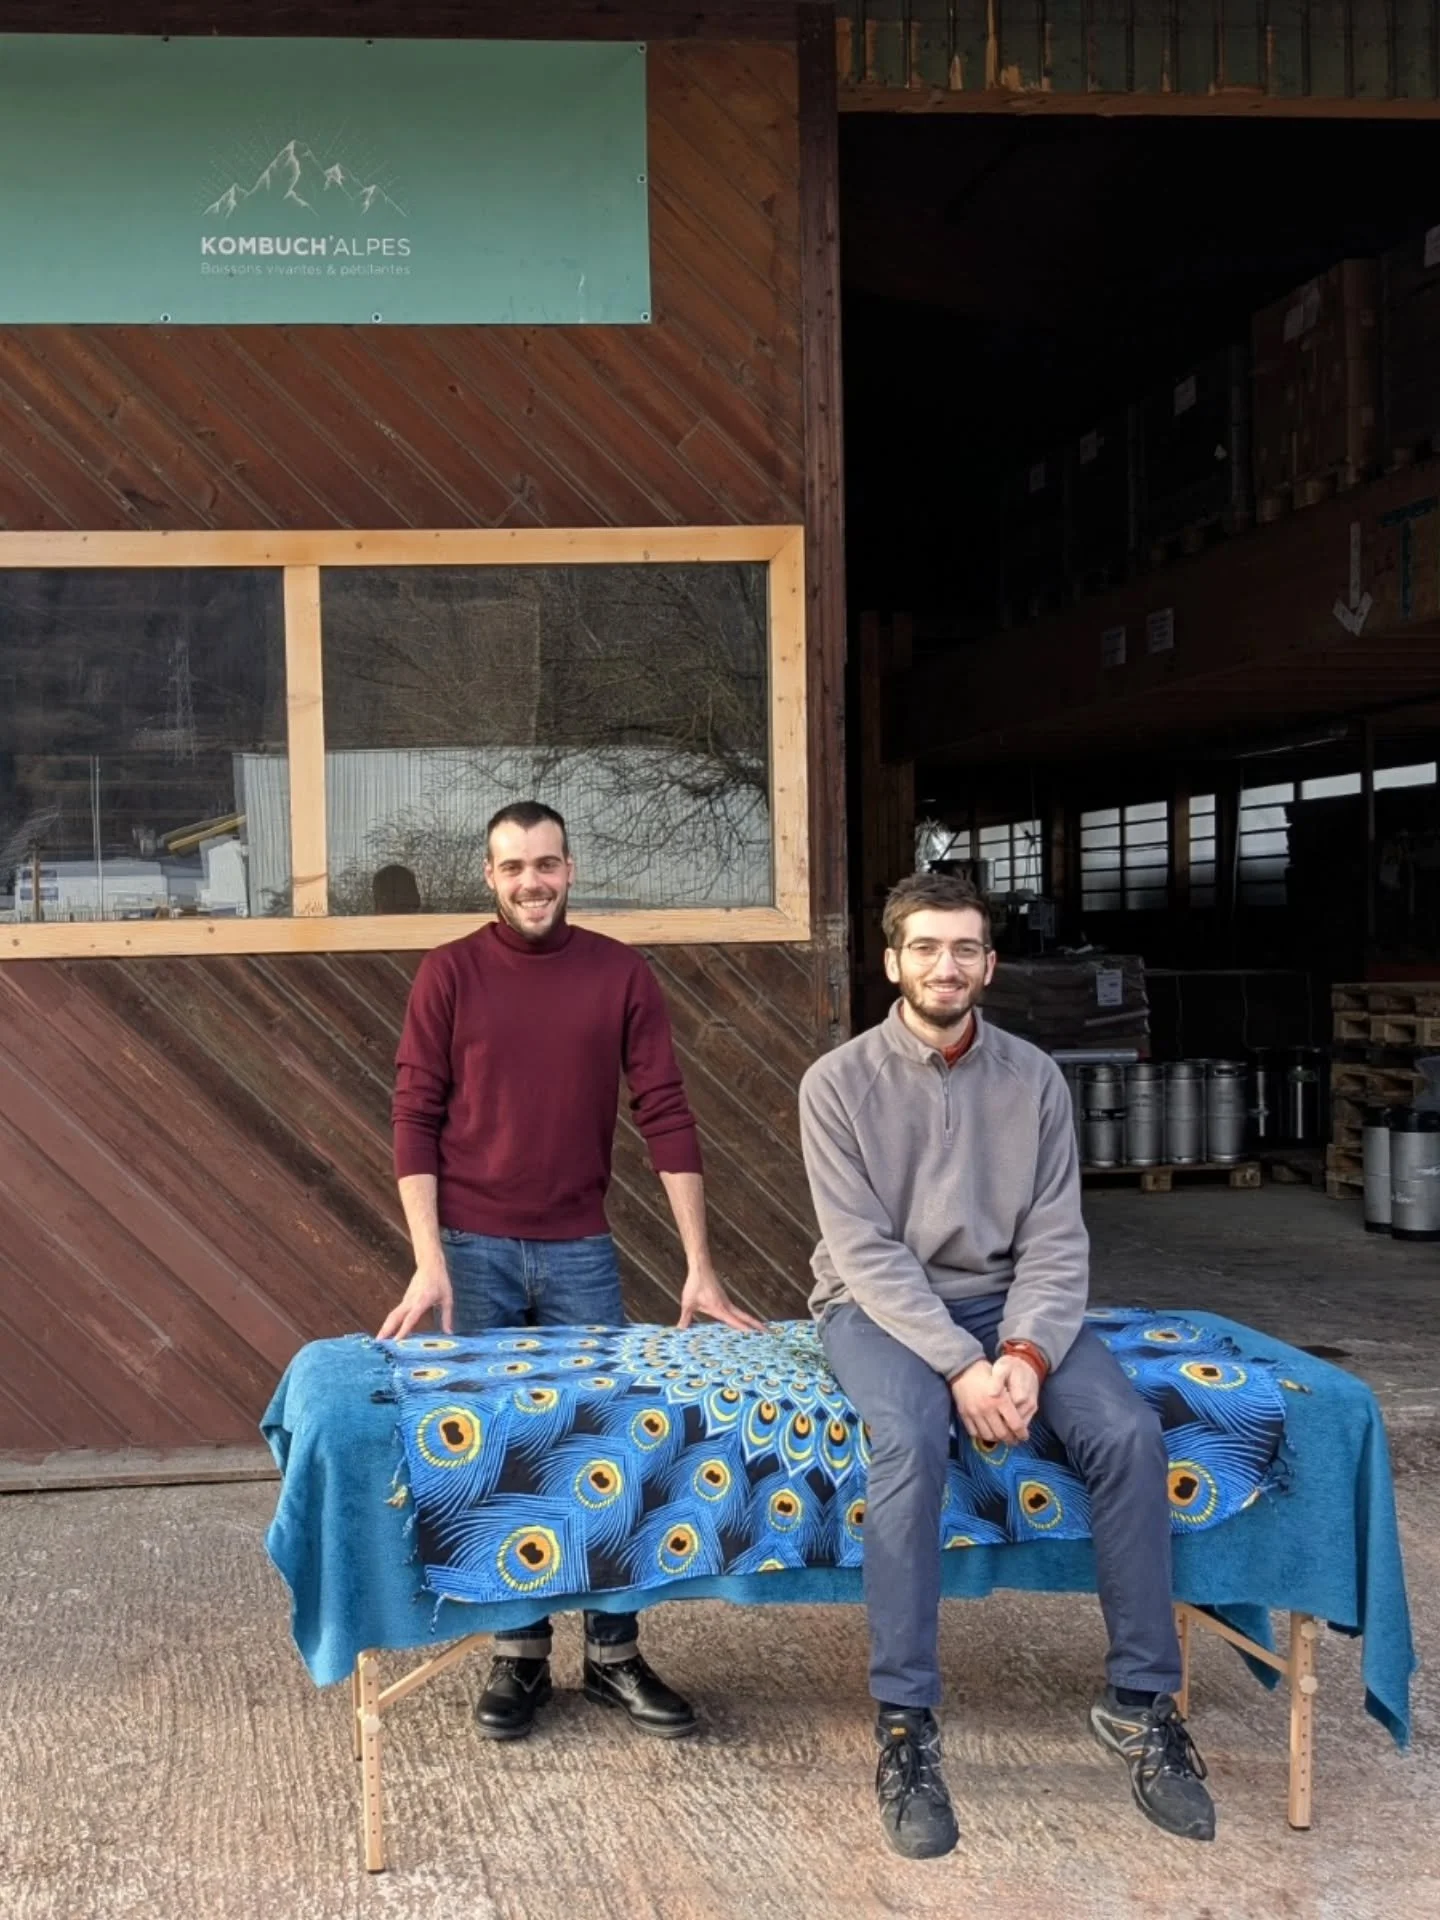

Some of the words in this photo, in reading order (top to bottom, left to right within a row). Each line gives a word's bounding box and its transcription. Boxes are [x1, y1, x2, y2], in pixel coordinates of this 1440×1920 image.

[200, 235, 412, 257] KOMBUCH'ALPES
[200, 261, 263, 275] Boissons
[266, 262, 322, 275] vivantes
[326, 263, 337, 276] &
